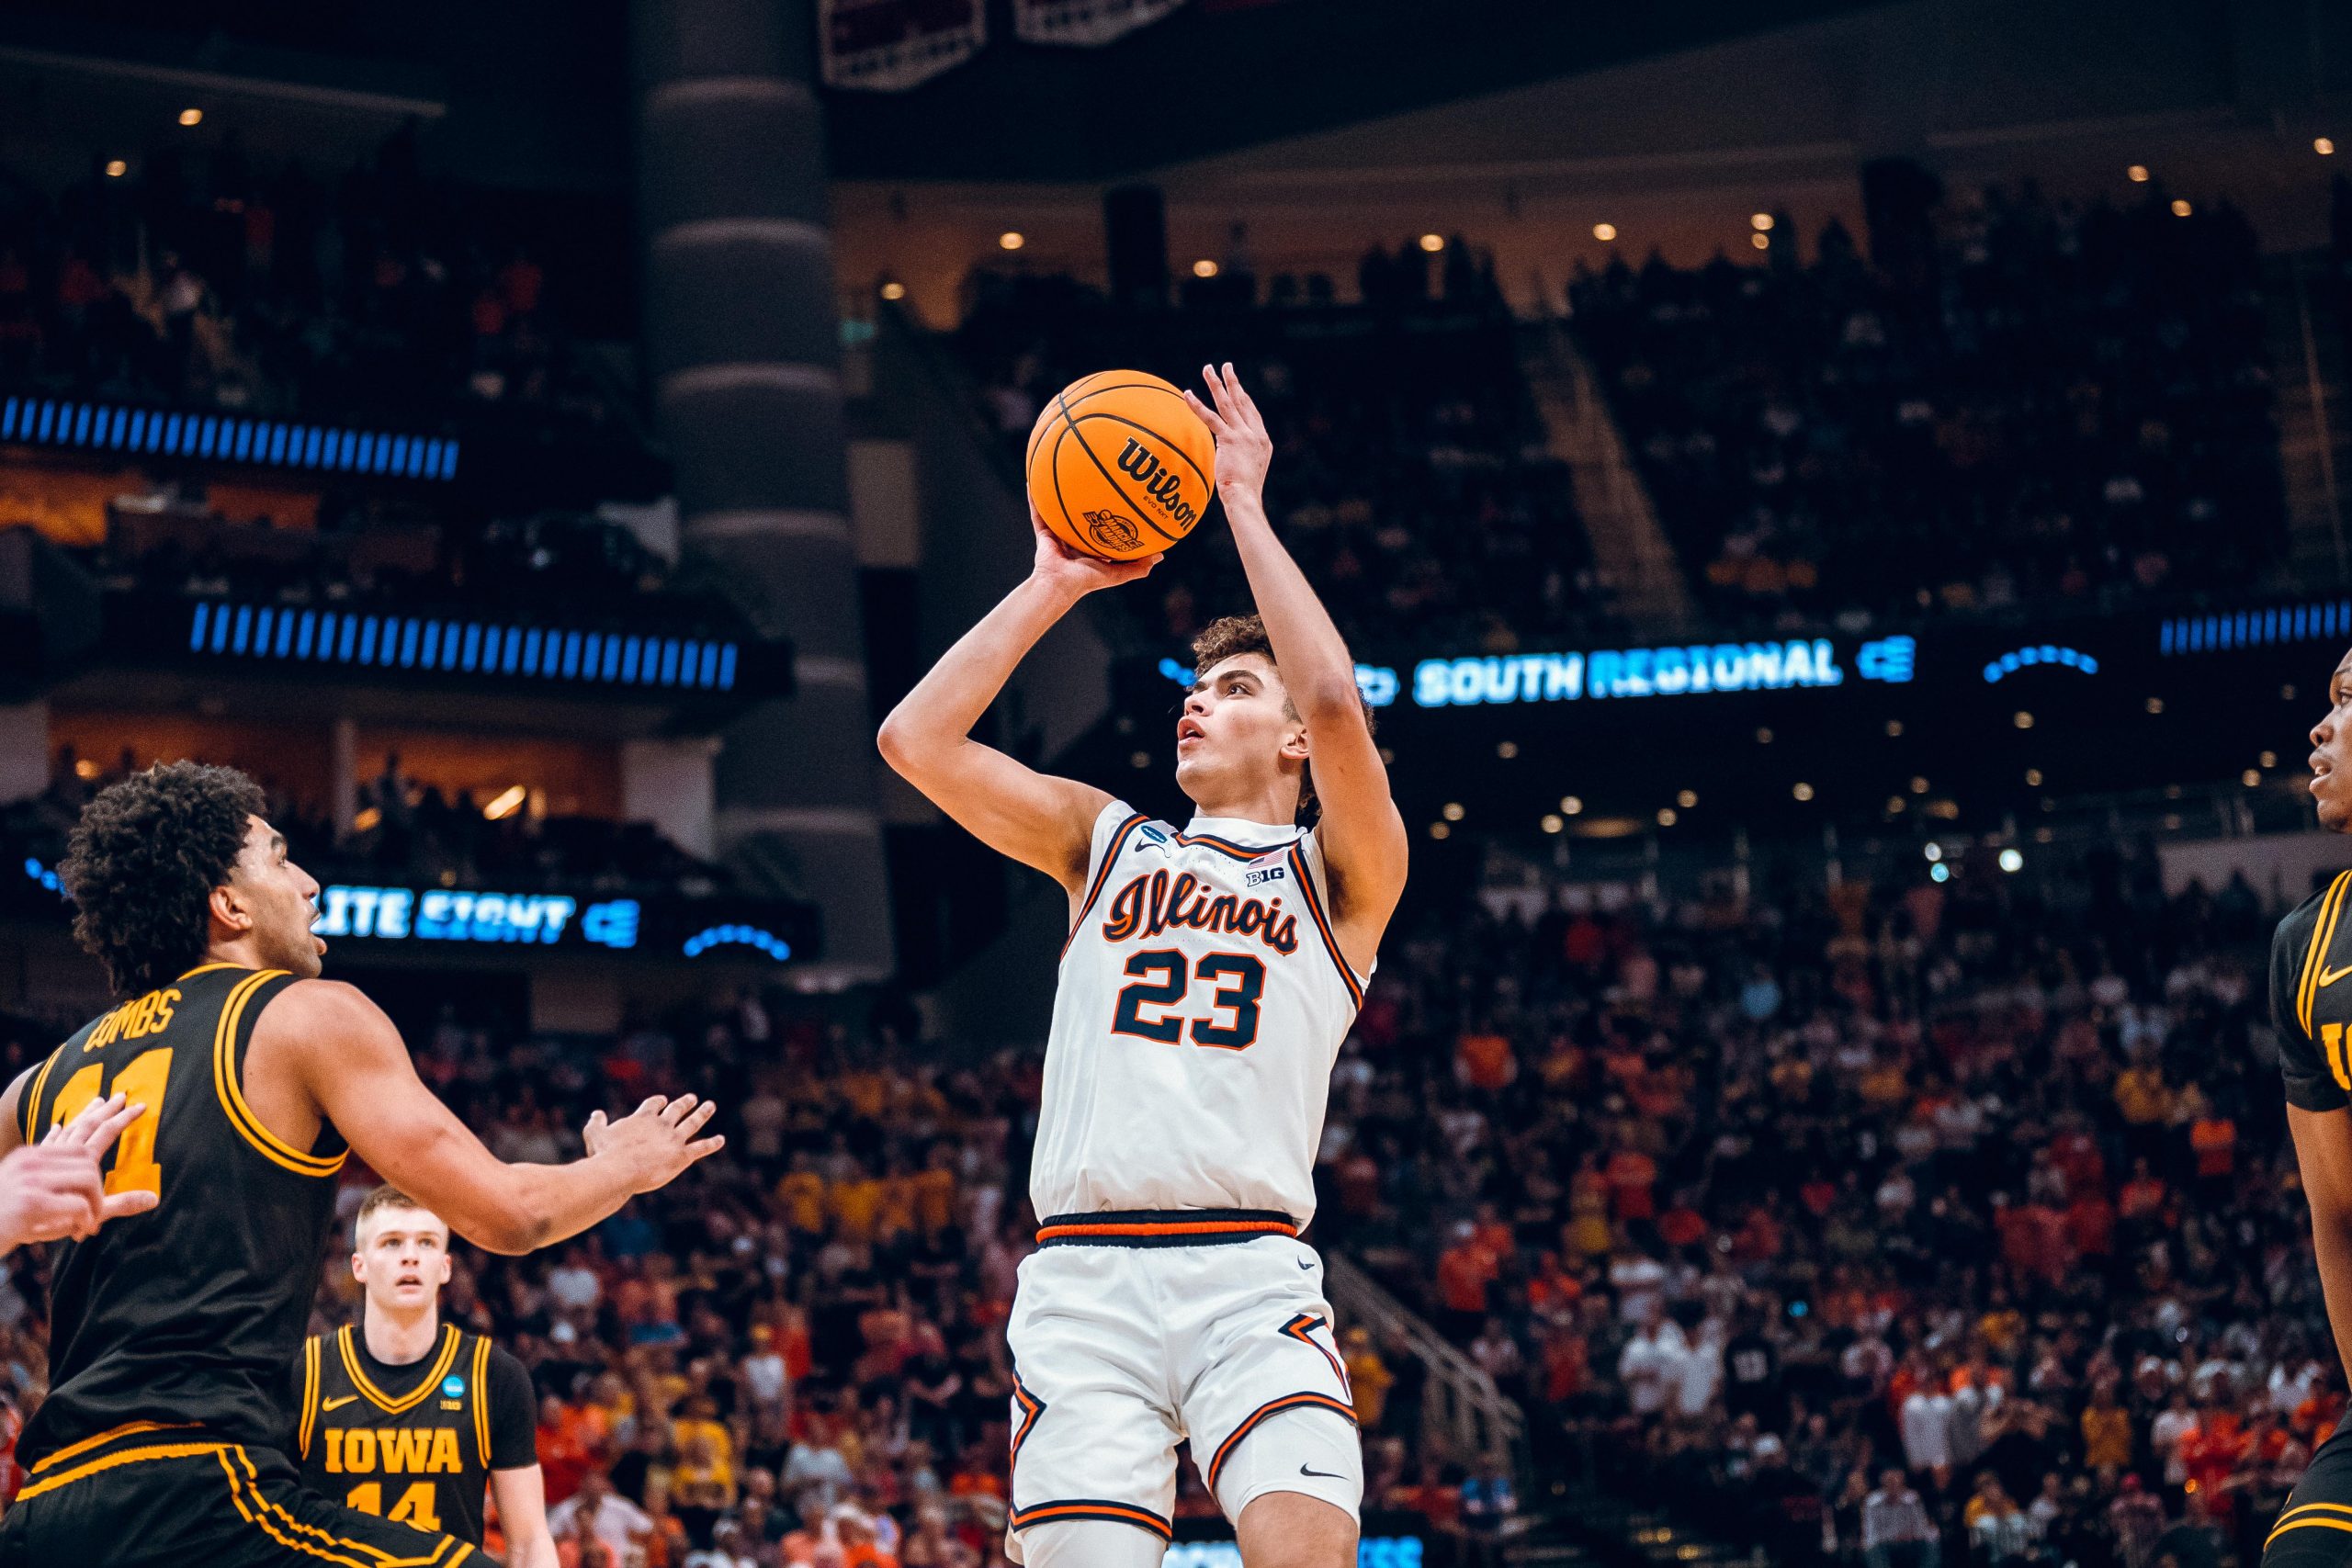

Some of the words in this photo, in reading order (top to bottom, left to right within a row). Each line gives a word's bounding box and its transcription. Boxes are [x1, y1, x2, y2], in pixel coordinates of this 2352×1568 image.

[1117, 435, 1196, 531] Wilson
[1143, 495, 1157, 508] EVO
[1157, 508, 1169, 520] NXT
[1102, 516, 1133, 543] MARCH
[1413, 651, 1585, 706] SOUTH
[1588, 638, 1843, 698] REGIONAL
[311, 885, 413, 938] ITE
[414, 890, 575, 943] EIGHT
[1102, 868, 1298, 955] Illinois
[1111, 948, 1266, 1051] 23
[324, 1428, 462, 1473] IOWA
[346, 1481, 441, 1531] 14
